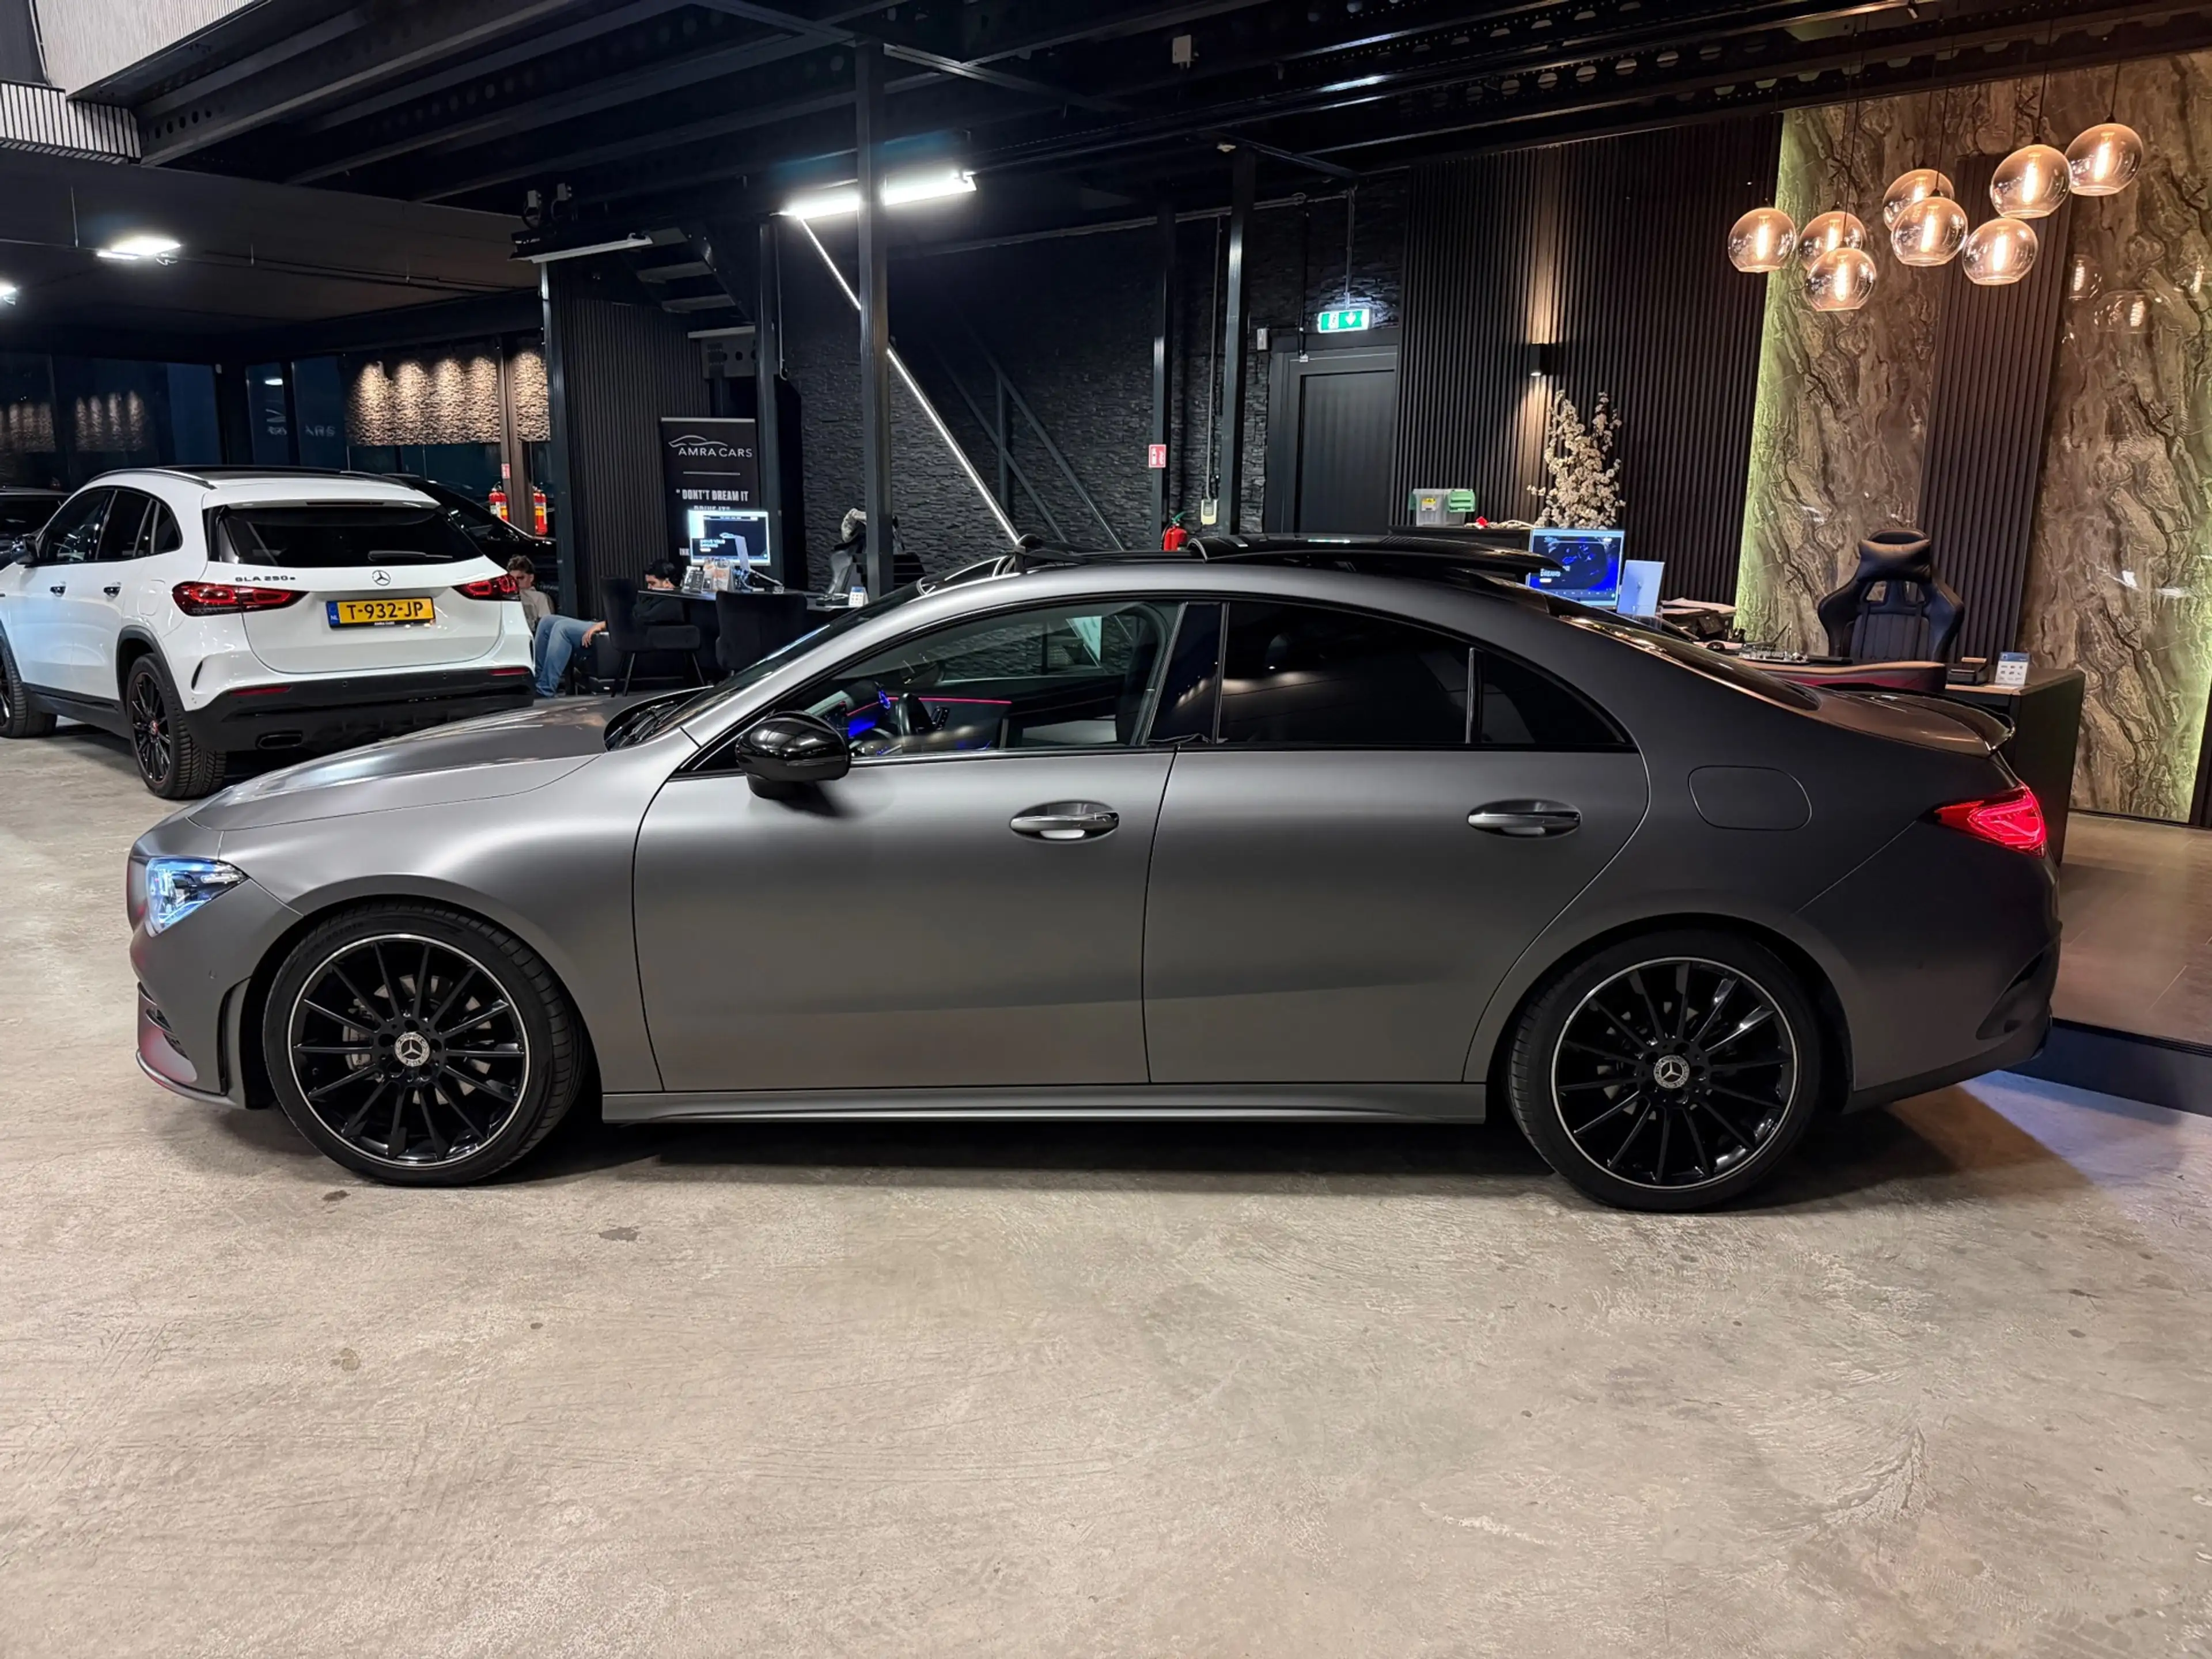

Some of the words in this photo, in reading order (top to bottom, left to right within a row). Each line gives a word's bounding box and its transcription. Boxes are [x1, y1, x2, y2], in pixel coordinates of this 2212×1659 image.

[679, 448, 716, 456] AMRA
[719, 448, 752, 457] CARS
[712, 490, 739, 501] DREAM
[741, 491, 748, 501] IT
[347, 601, 423, 619] T-932-JP
